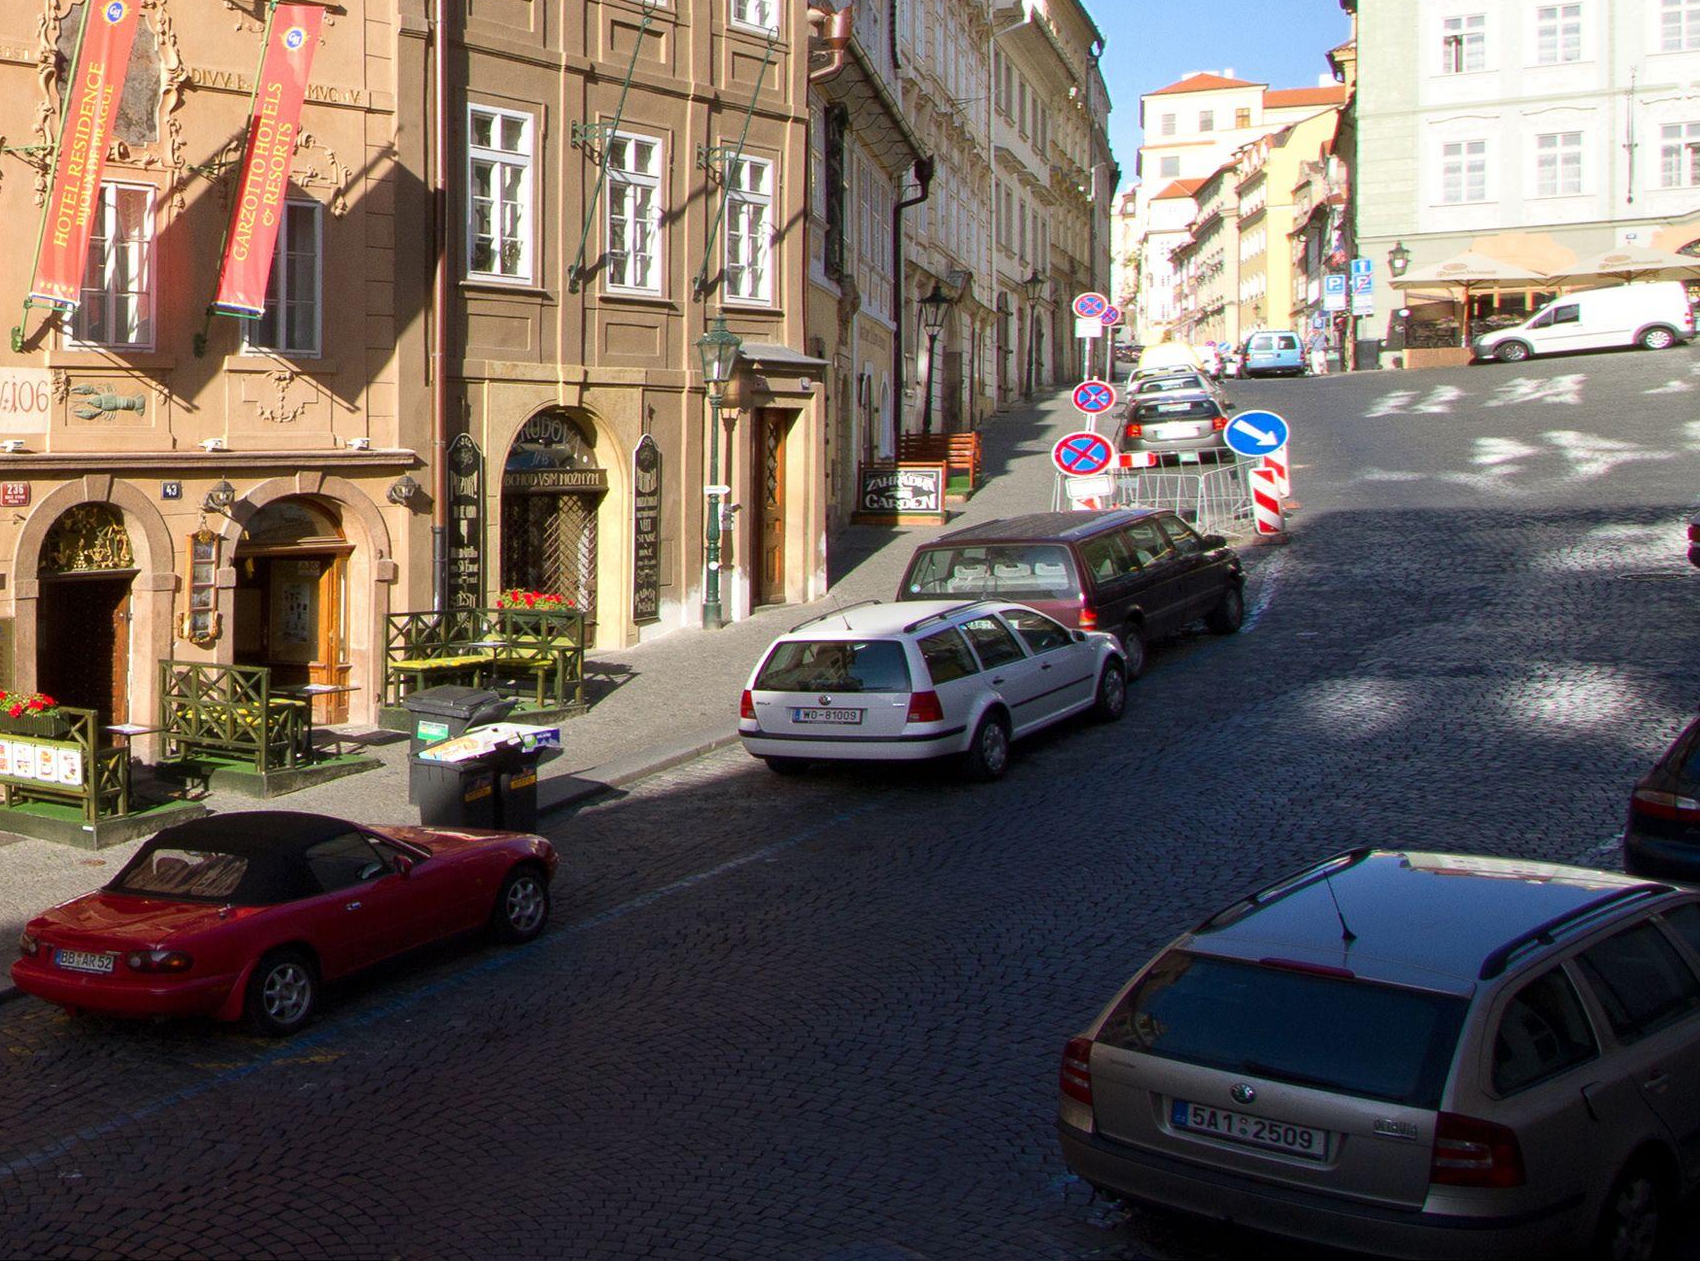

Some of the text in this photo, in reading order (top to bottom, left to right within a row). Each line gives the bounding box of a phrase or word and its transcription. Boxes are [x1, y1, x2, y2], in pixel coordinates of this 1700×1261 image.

[53, 61, 105, 248] HOTEL RESIDENCE
[76, 83, 115, 226] BIJOUX DE PRAGUE
[233, 82, 283, 261] GARZOTTO HOTELS
[262, 121, 293, 227] & RESORTS
[7, 484, 24, 495] 236
[166, 485, 177, 496] 43
[505, 474, 537, 486] BCHOD
[865, 493, 936, 509] GARDEN
[1253, 1120, 1313, 1149] 2509
